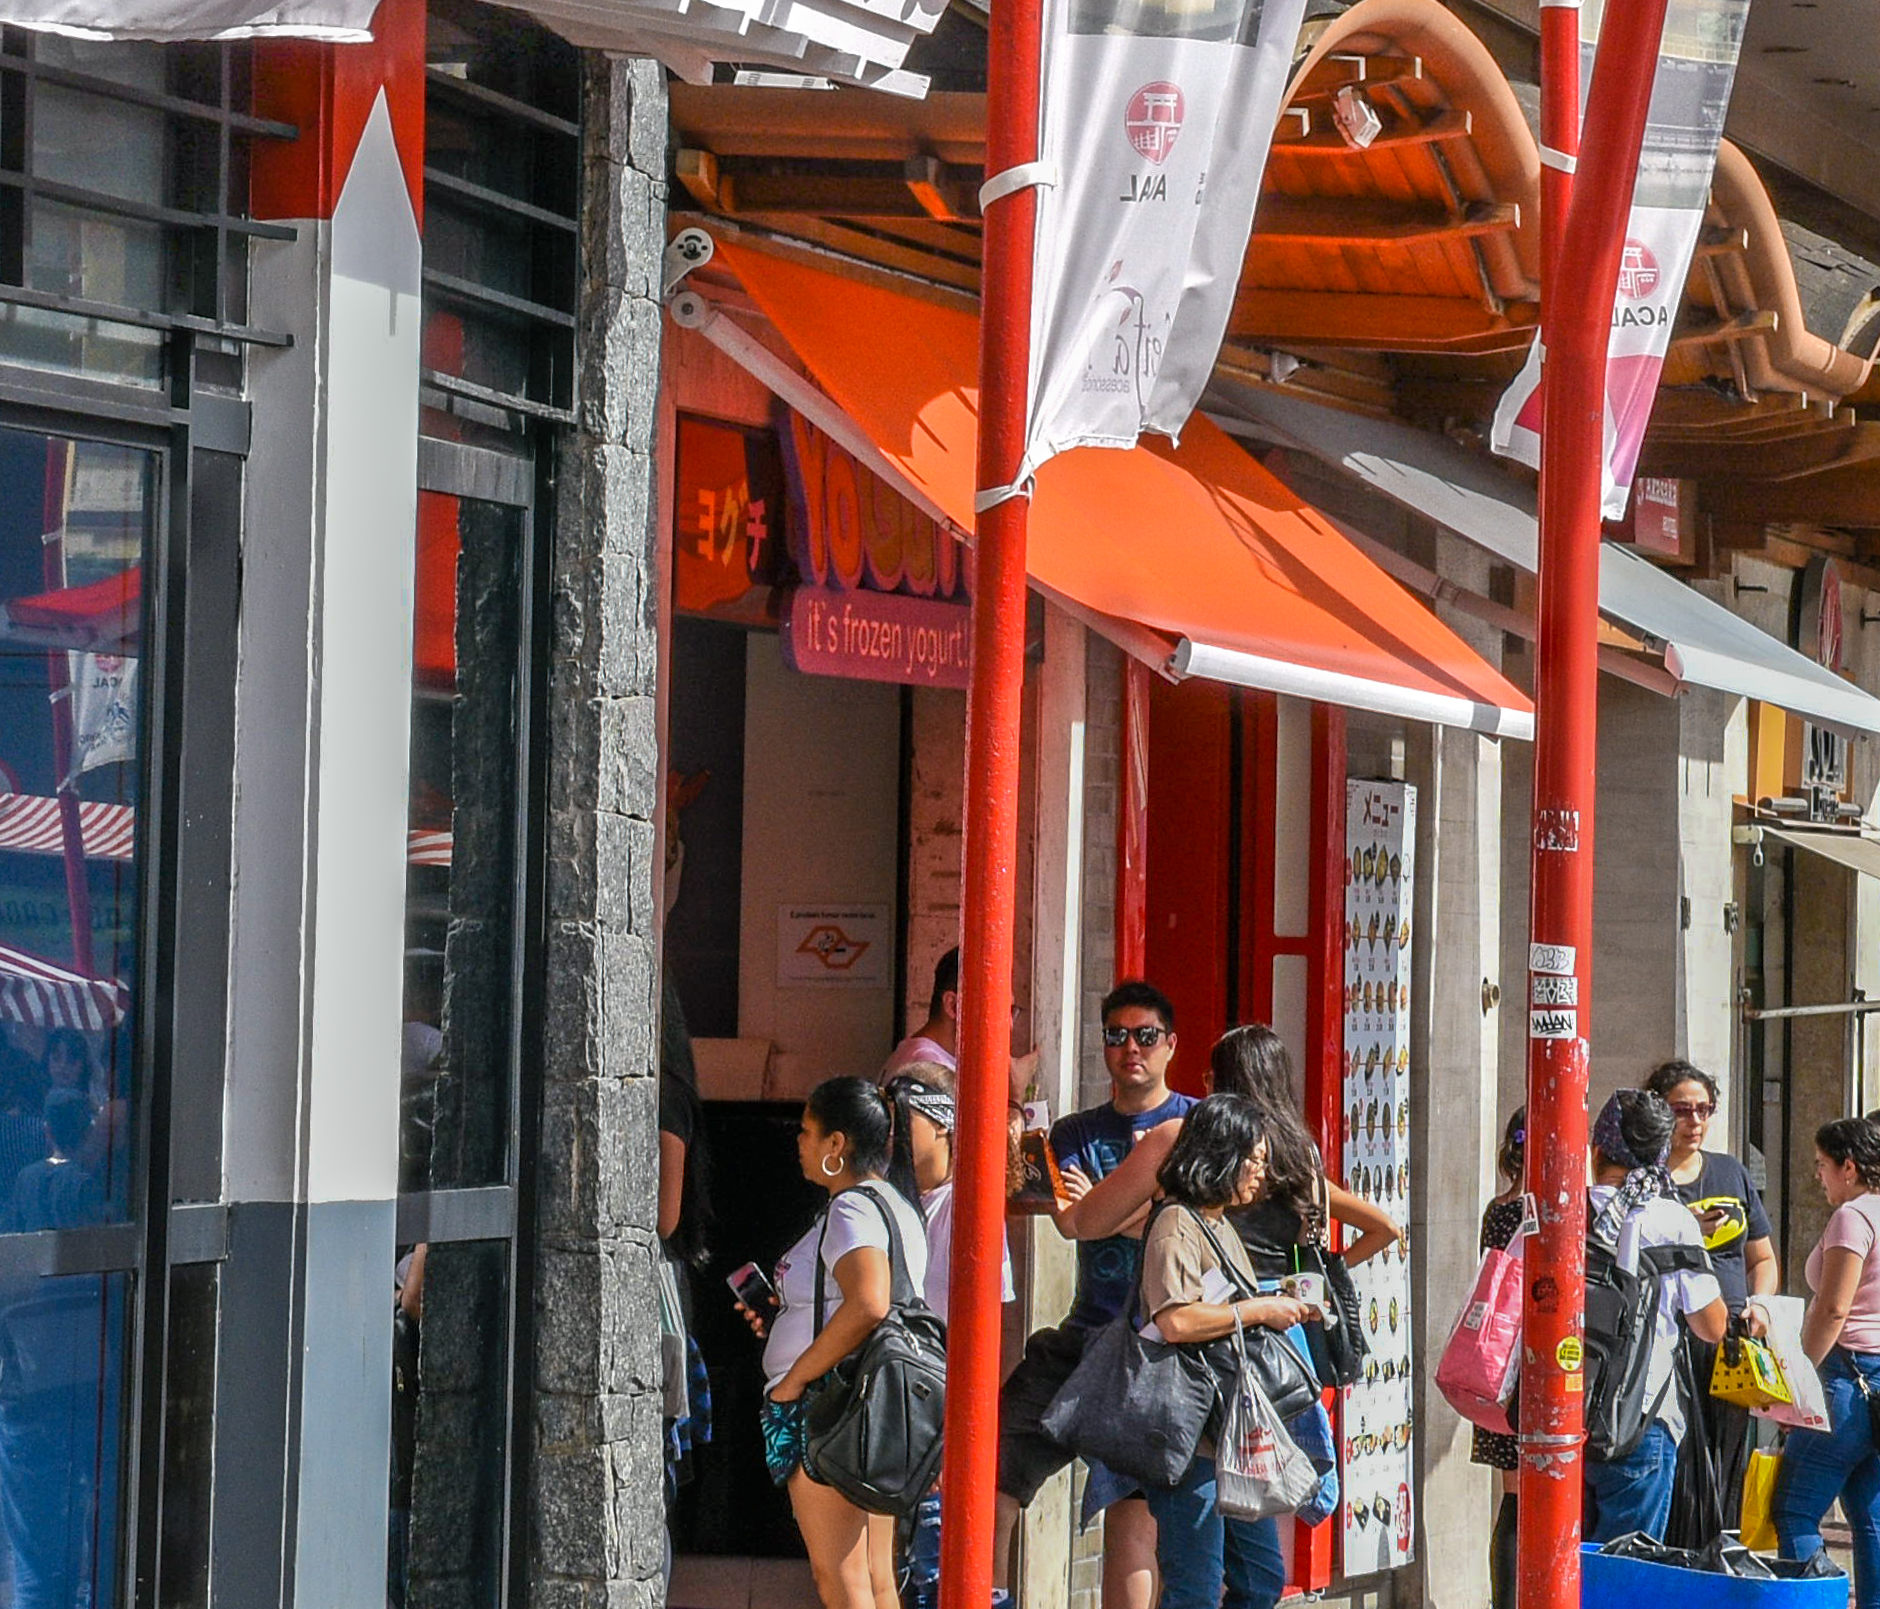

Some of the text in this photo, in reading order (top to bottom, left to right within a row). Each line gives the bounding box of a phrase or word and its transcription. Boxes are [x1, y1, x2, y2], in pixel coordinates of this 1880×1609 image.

[843, 604, 902, 659] frozen
[1363, 791, 1399, 828] メニュー
